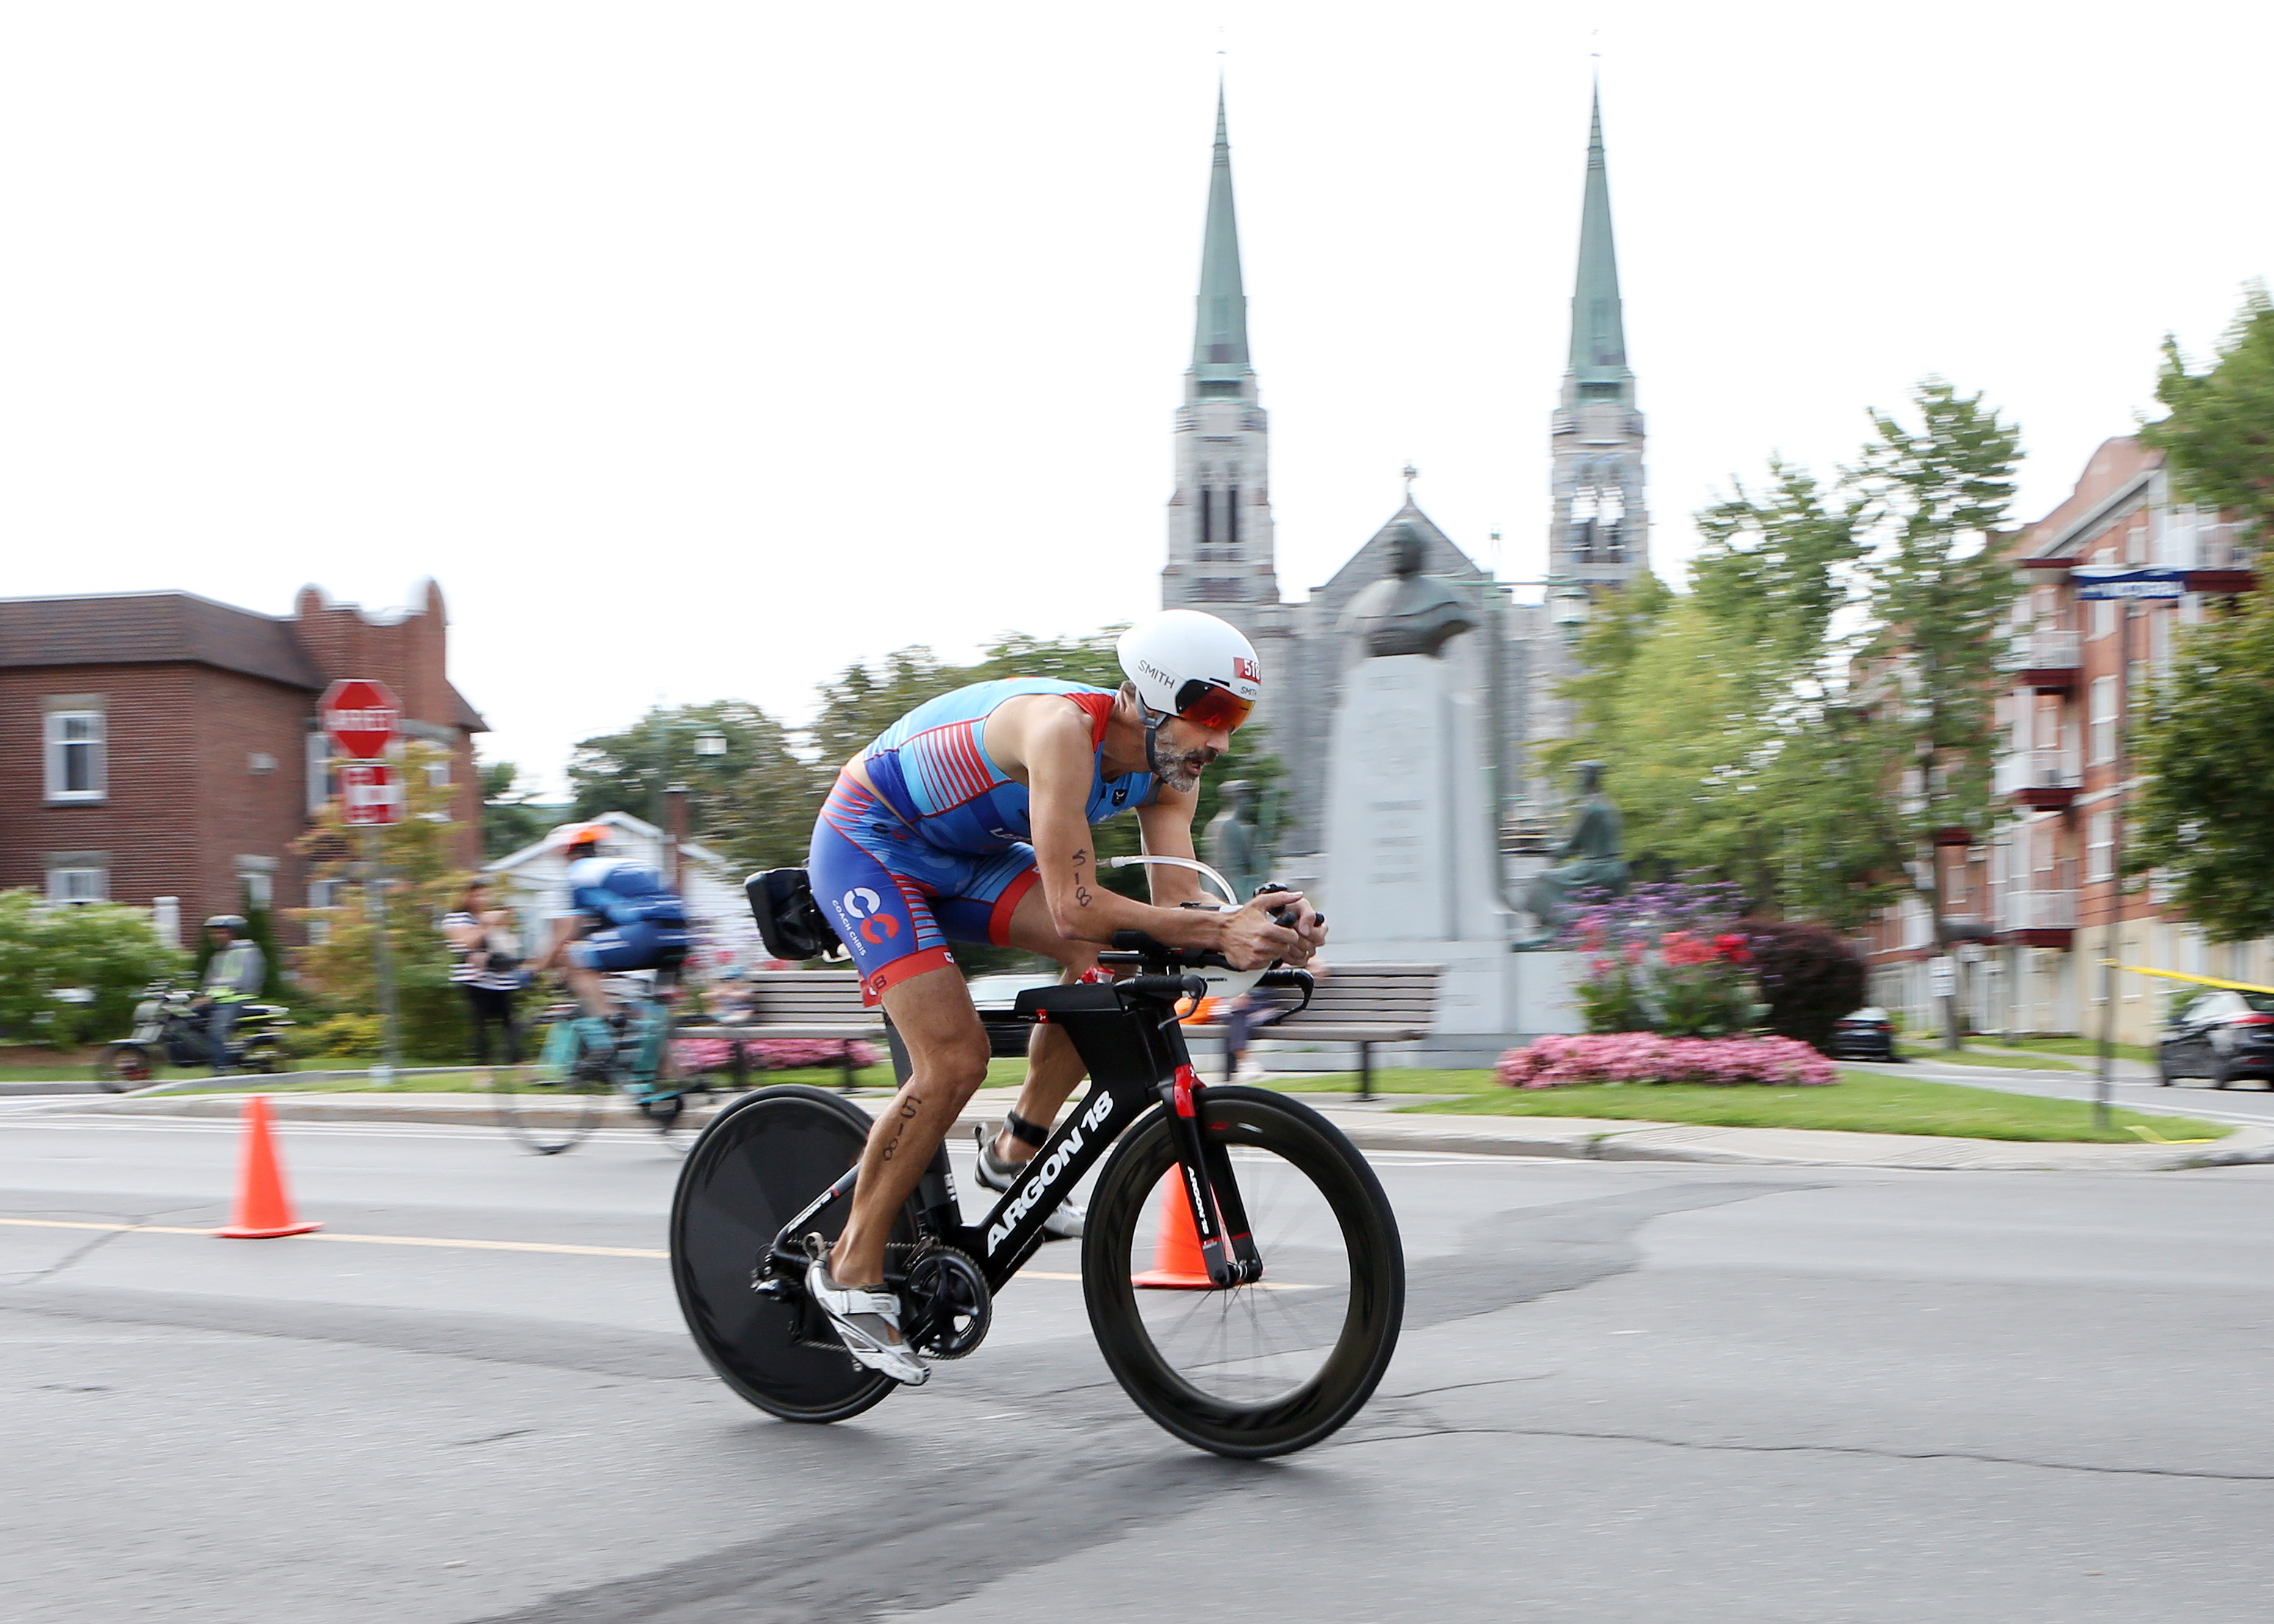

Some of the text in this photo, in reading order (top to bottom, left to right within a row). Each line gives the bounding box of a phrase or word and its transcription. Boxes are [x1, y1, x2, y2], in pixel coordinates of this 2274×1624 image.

[1138, 659, 1175, 689] SMITH
[1243, 659, 1260, 680] 518
[1072, 848, 1092, 907] 518
[832, 899, 868, 956] COACH CHRIS
[882, 1095, 922, 1161] 518
[987, 1090, 1114, 1258] ARGON 18
[1187, 1165, 1206, 1219] ARGON
